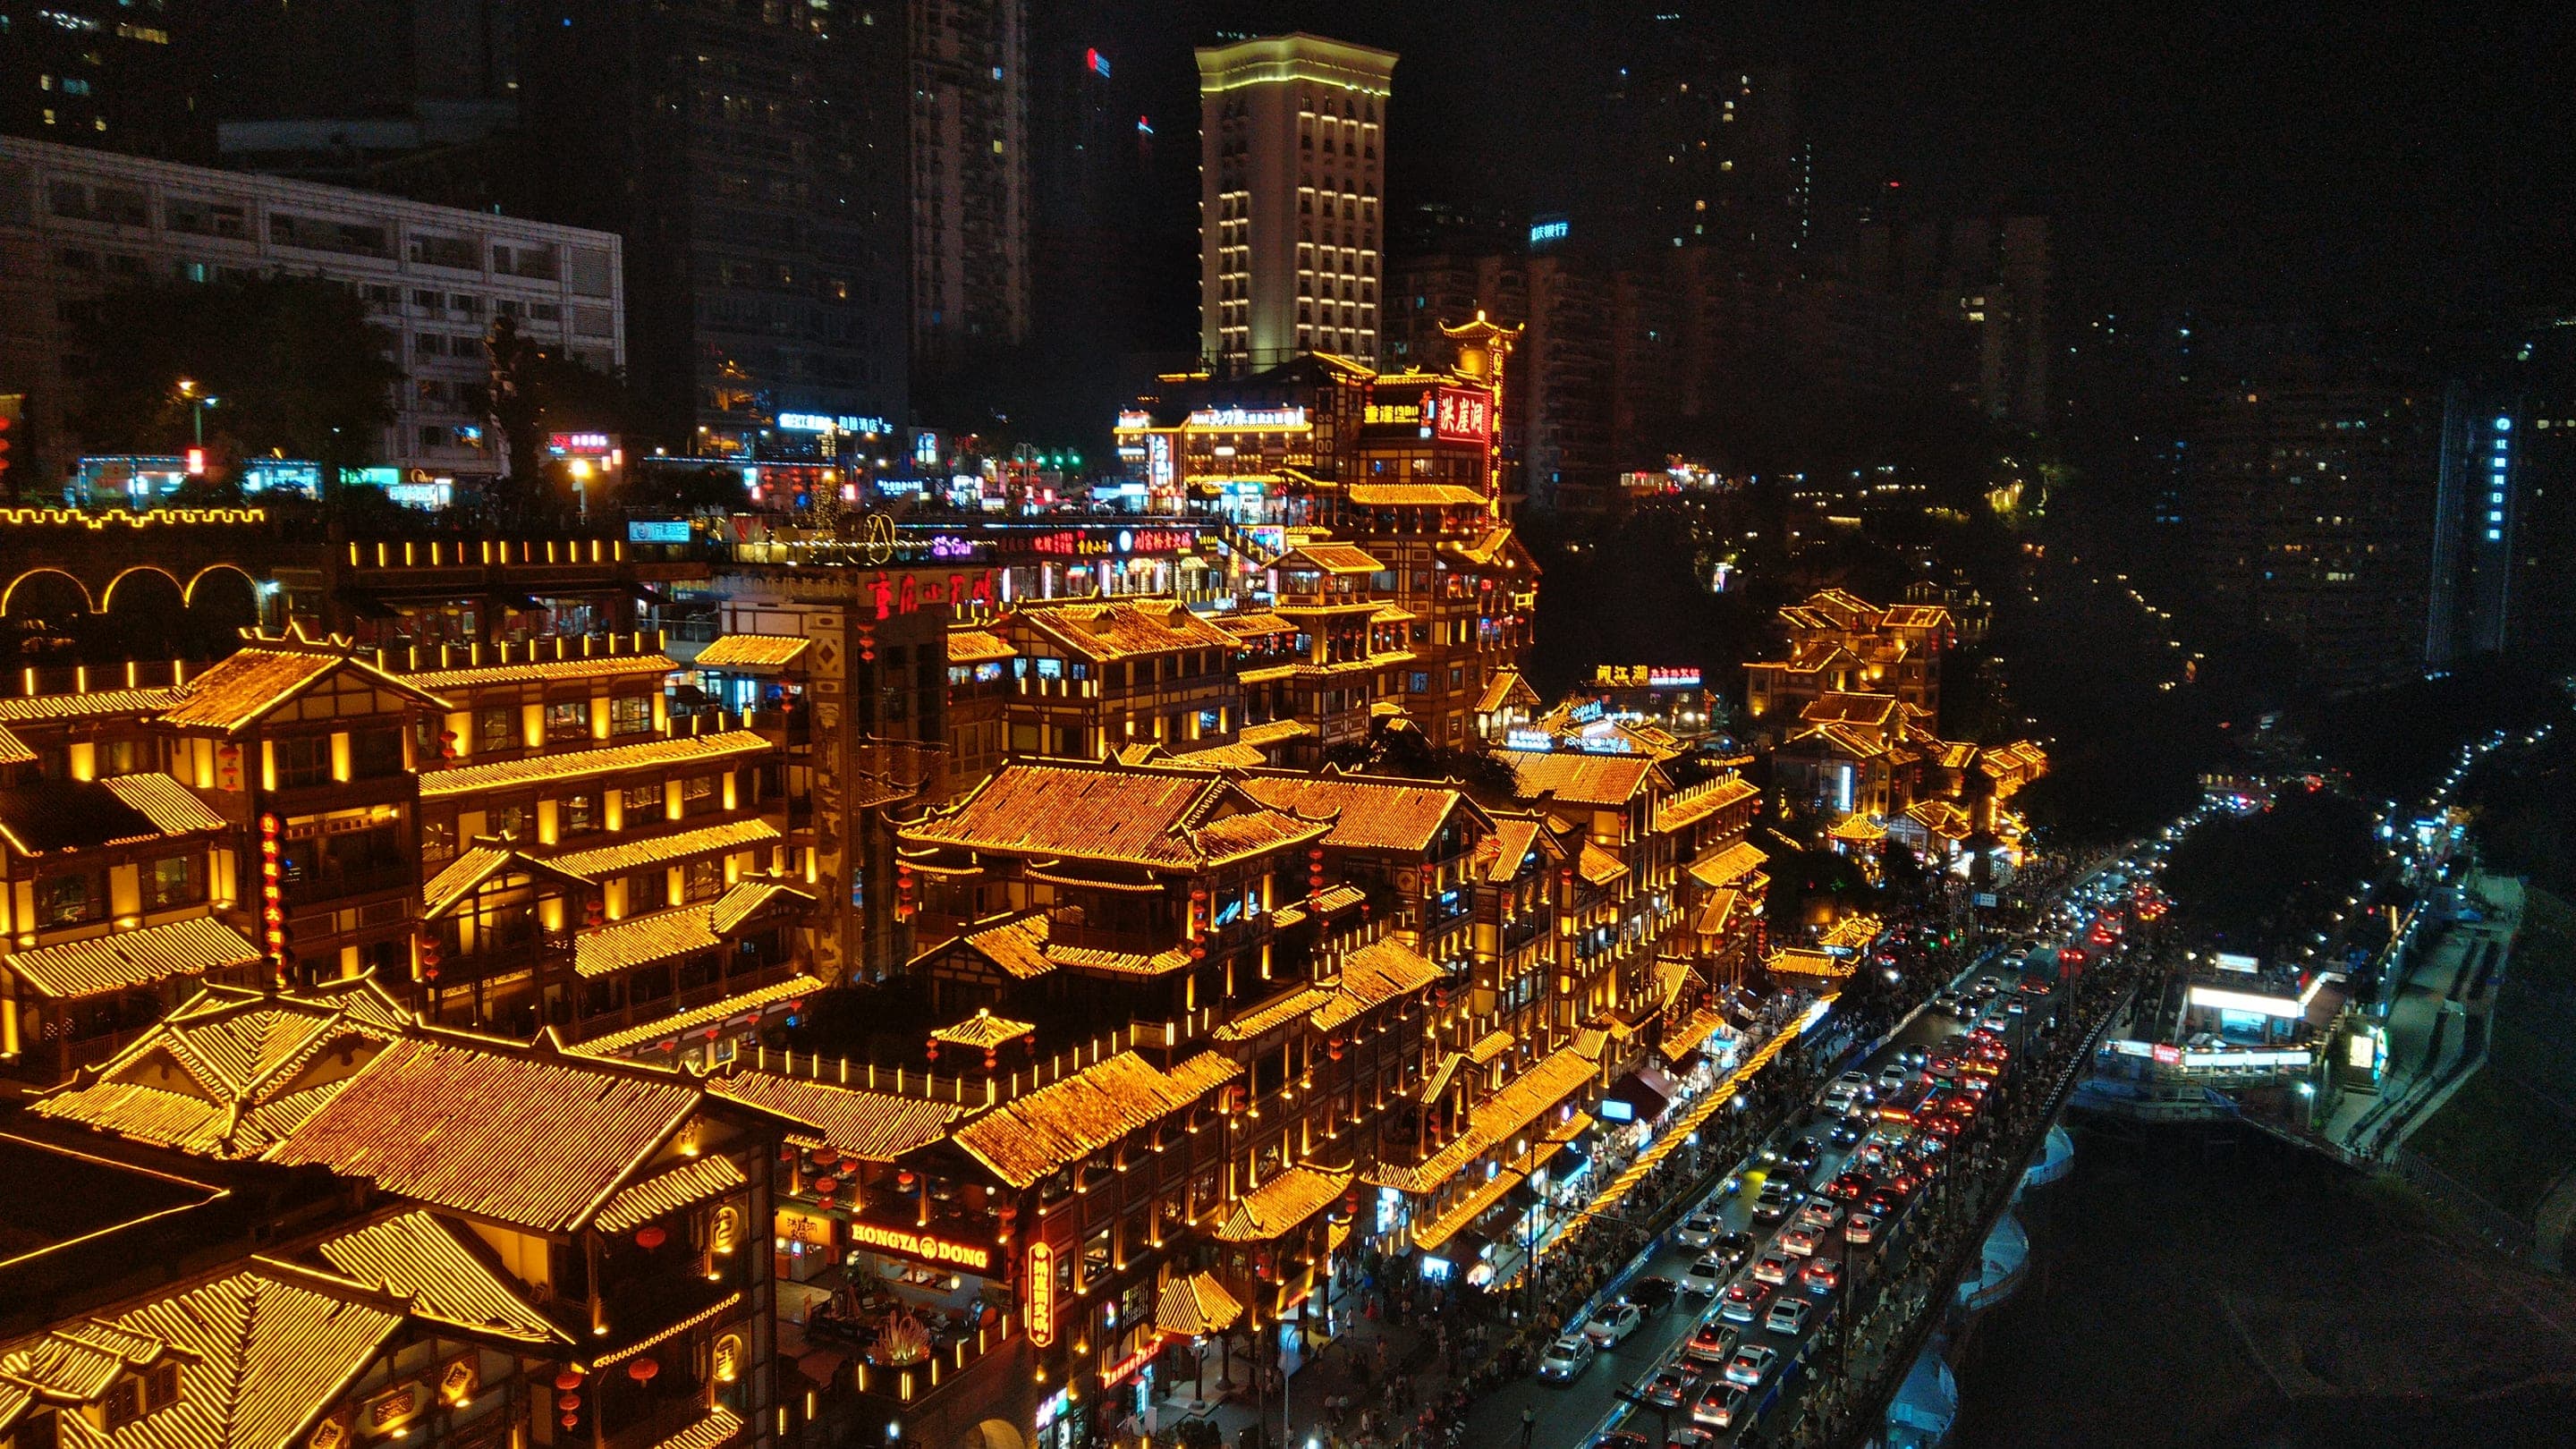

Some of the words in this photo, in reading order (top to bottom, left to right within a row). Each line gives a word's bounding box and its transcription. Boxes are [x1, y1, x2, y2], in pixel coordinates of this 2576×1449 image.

[1441, 395, 1484, 435] 洪崖洞
[852, 1224, 919, 1254] HONGYA
[937, 1241, 988, 1269] DONG
